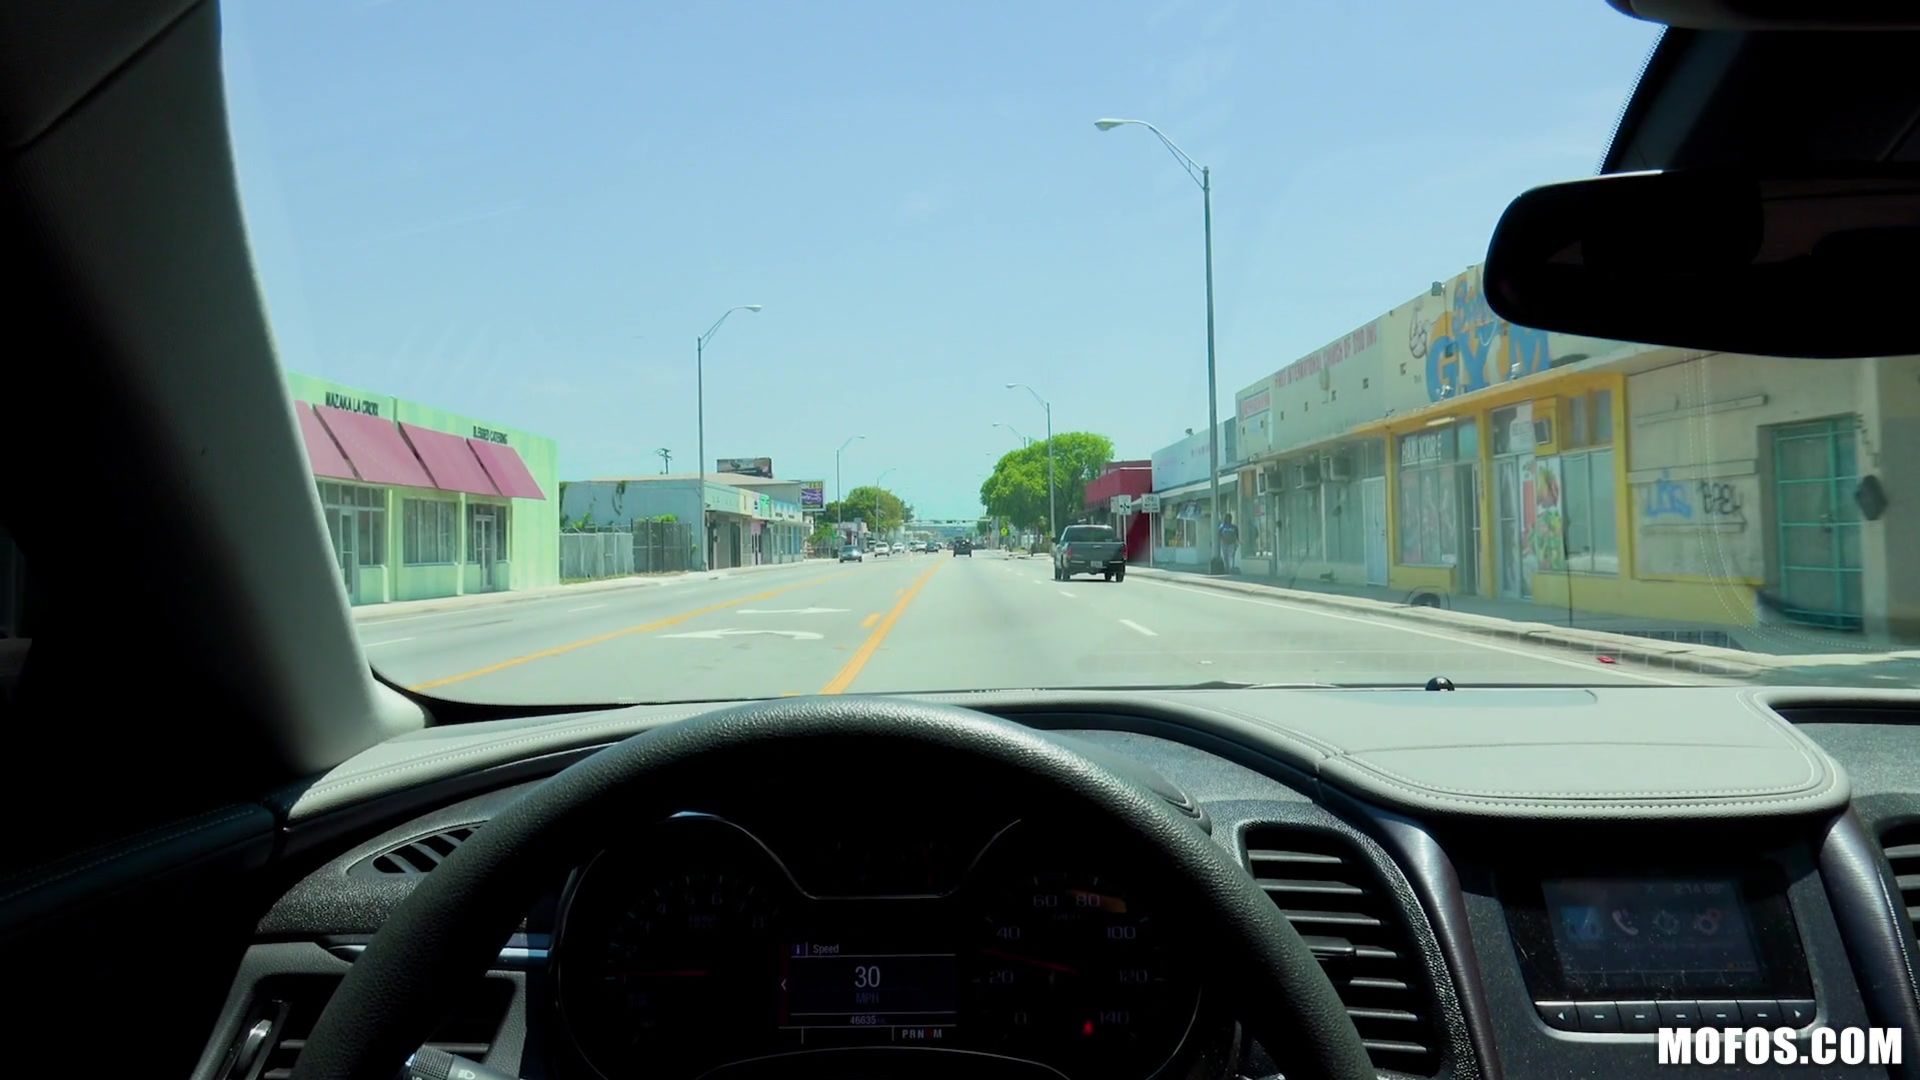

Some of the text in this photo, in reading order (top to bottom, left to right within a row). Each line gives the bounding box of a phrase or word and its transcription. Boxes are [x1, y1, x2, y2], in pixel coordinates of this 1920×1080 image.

[1425, 324, 1551, 402] GYM
[1032, 894, 1058, 907] 60
[1075, 893, 1101, 907] 80
[996, 926, 1021, 939] 40
[1106, 926, 1137, 940] 100
[812, 943, 840, 956] Speed
[854, 965, 881, 988] 30
[988, 971, 1014, 984] 20
[1119, 969, 1149, 984] 120
[855, 992, 880, 1005] MPH
[1097, 1010, 1130, 1025] 140
